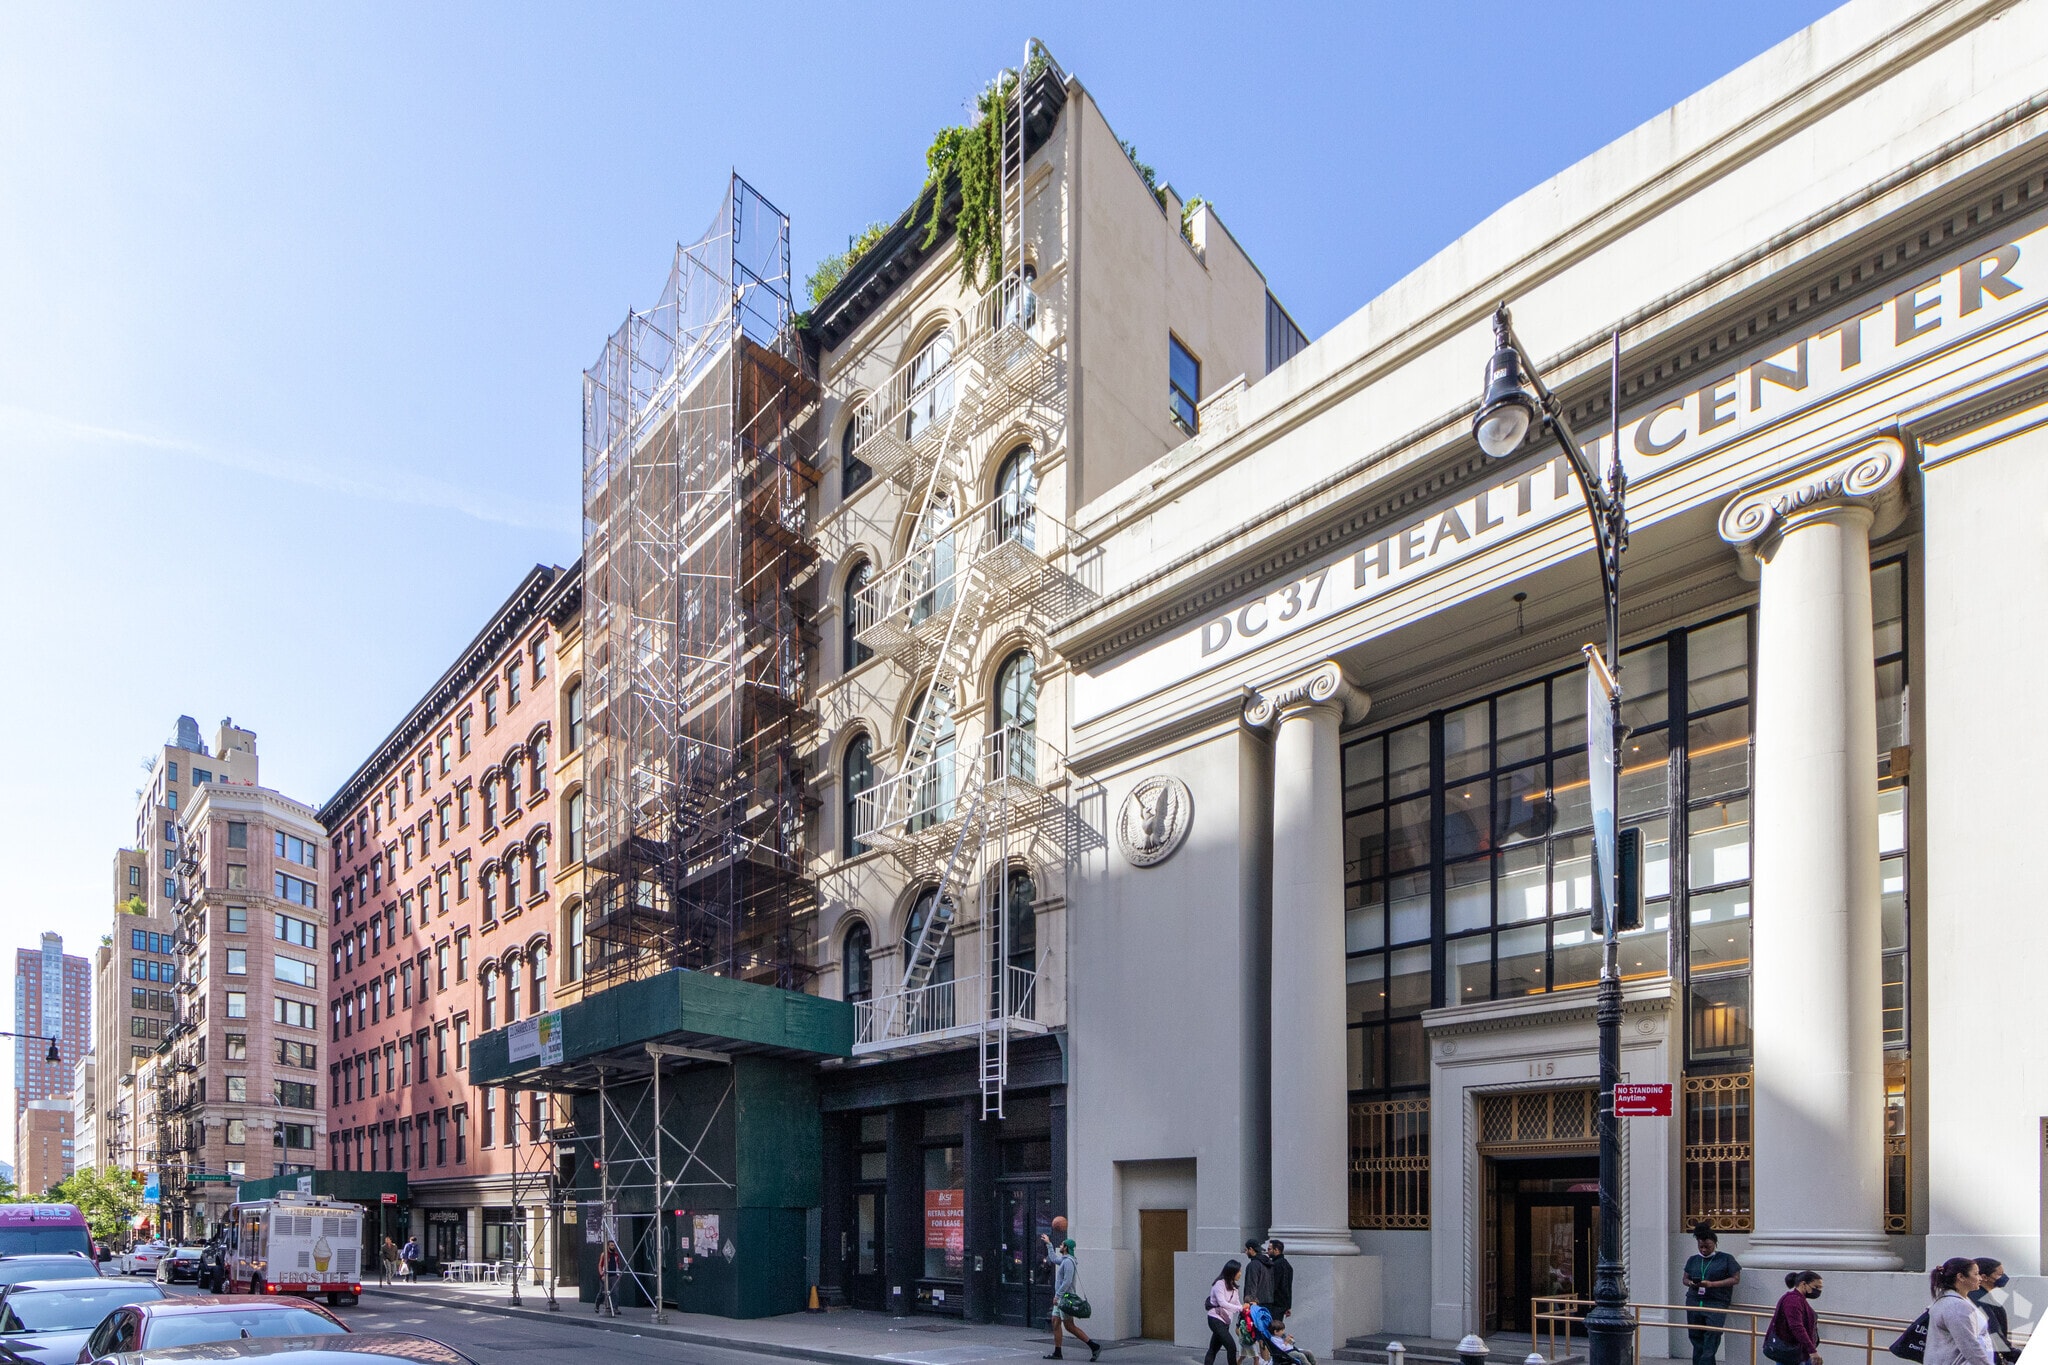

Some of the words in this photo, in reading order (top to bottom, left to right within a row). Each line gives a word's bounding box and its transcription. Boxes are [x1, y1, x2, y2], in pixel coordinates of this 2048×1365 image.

[1201, 596, 1269, 658] DC
[1279, 564, 1332, 620] 37
[1354, 437, 1600, 590] HEALTH
[1634, 244, 2024, 457] CENTER
[1529, 1062, 1554, 1077] 115
[1629, 1086, 1663, 1094] STANDING
[429, 1211, 459, 1223] sweetgreen
[947, 1209, 964, 1217] SPACE
[943, 1219, 961, 1227] LEASE
[279, 1271, 350, 1284] FROSTEE
